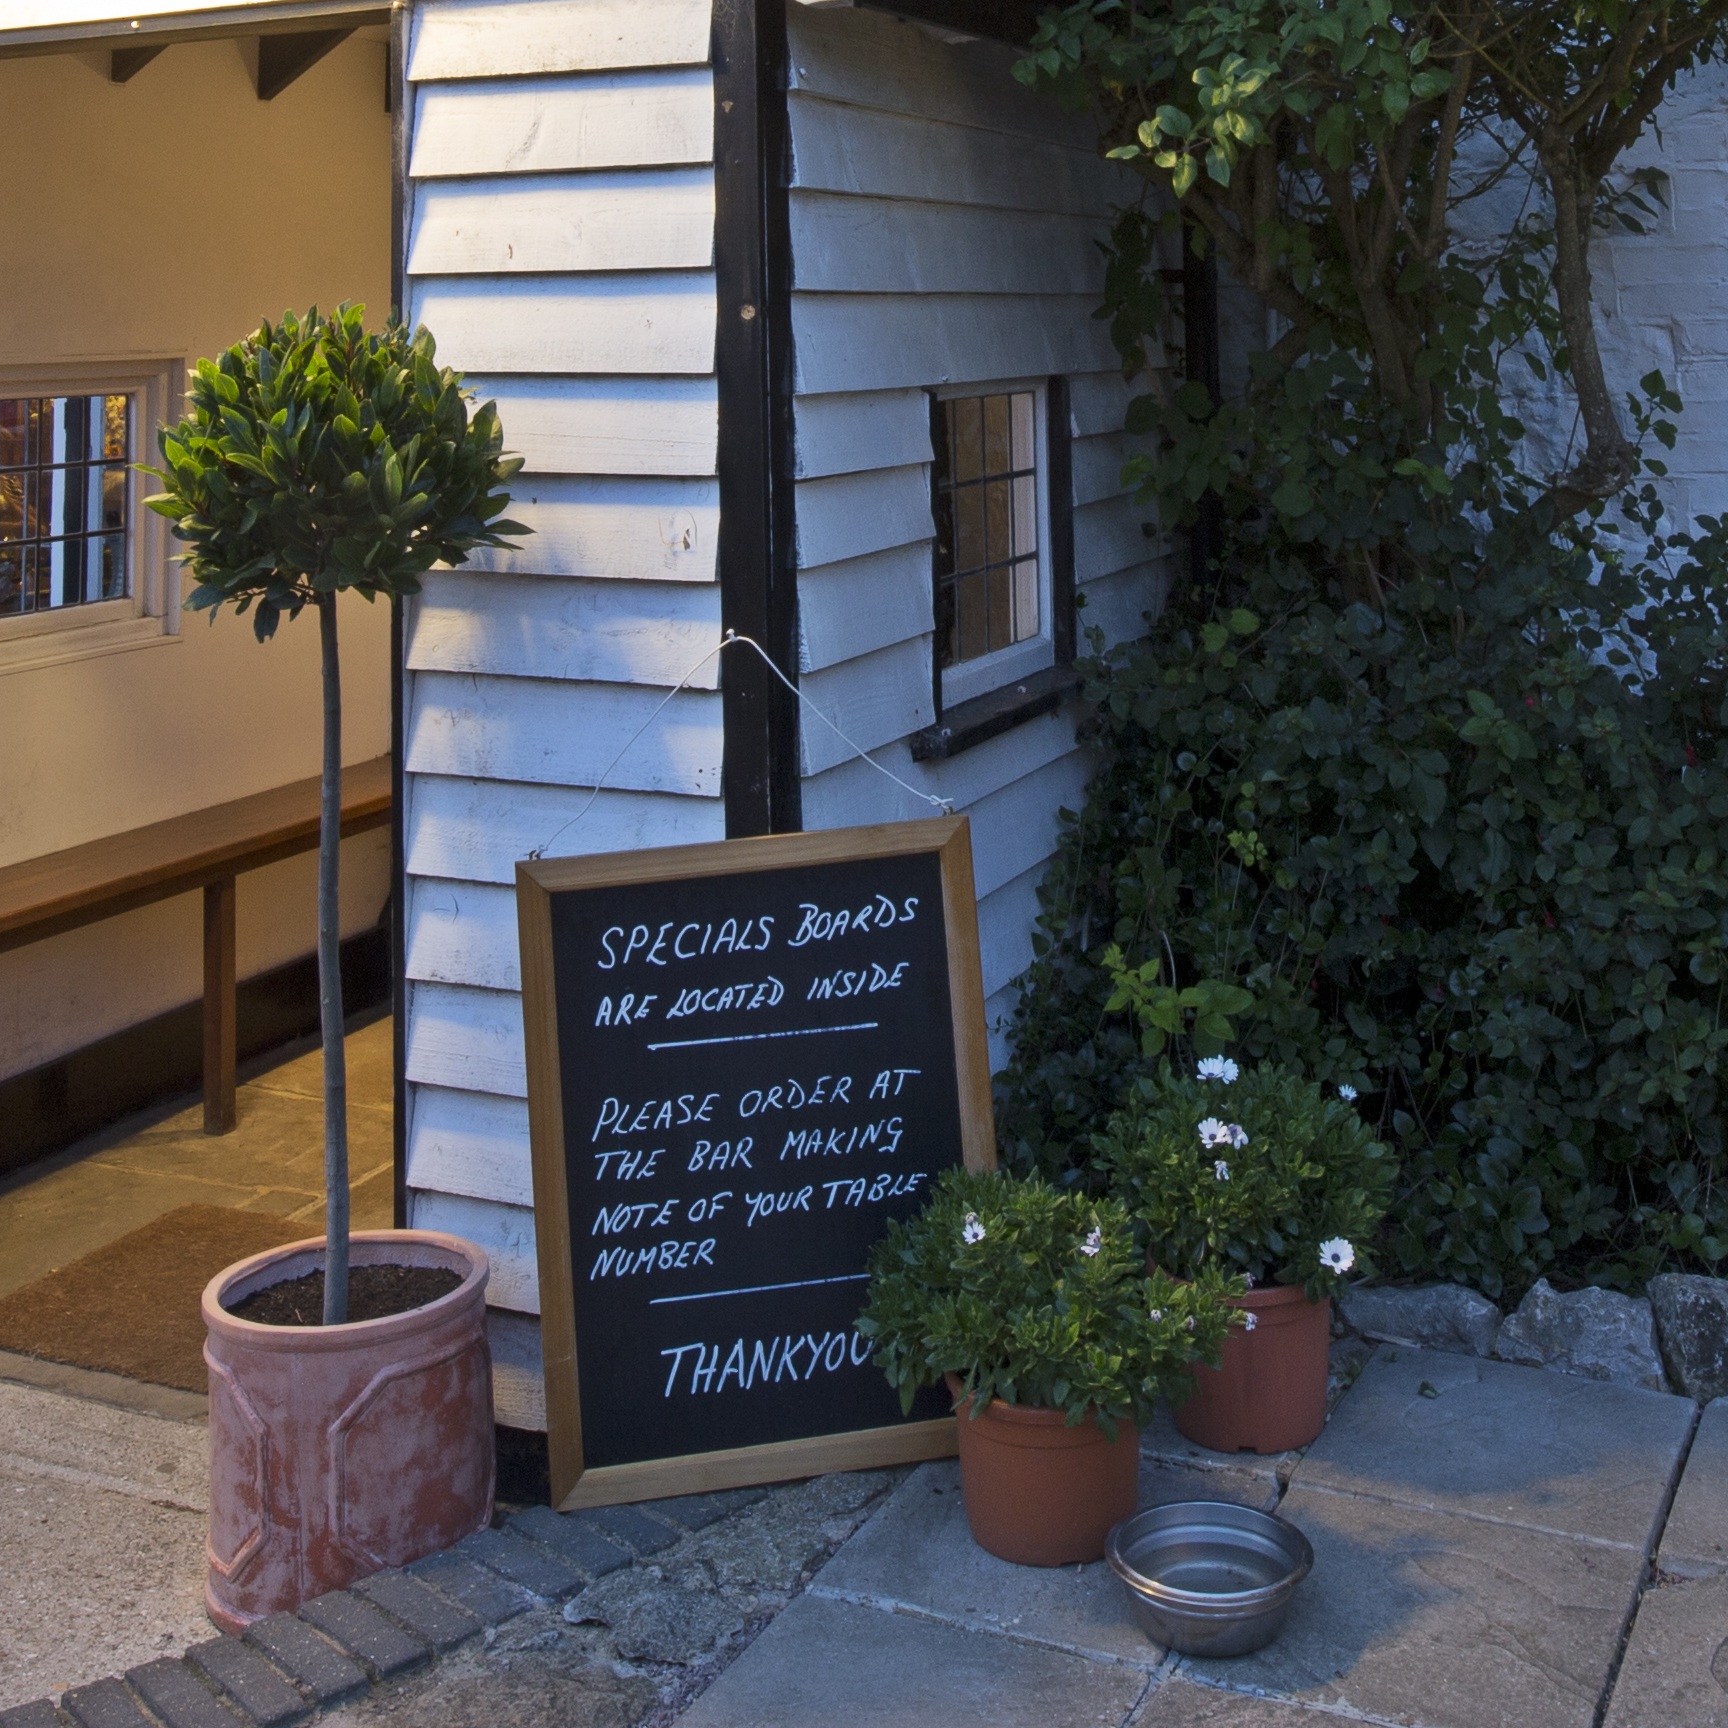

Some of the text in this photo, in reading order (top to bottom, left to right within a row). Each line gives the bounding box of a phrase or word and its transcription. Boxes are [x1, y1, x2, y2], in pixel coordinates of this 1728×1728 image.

[597, 896, 920, 969] SPECIALS BOARDS
[594, 962, 910, 1028] ARE LOCATED INSIDE
[591, 1068, 922, 1143] PLEASE ORDER AT
[594, 1116, 904, 1181] THE BAR MAKING
[591, 1172, 928, 1237] NOTE OF YOUR TABLE
[590, 1237, 717, 1282] NUMBER
[660, 1331, 874, 1398] THANKYOU
